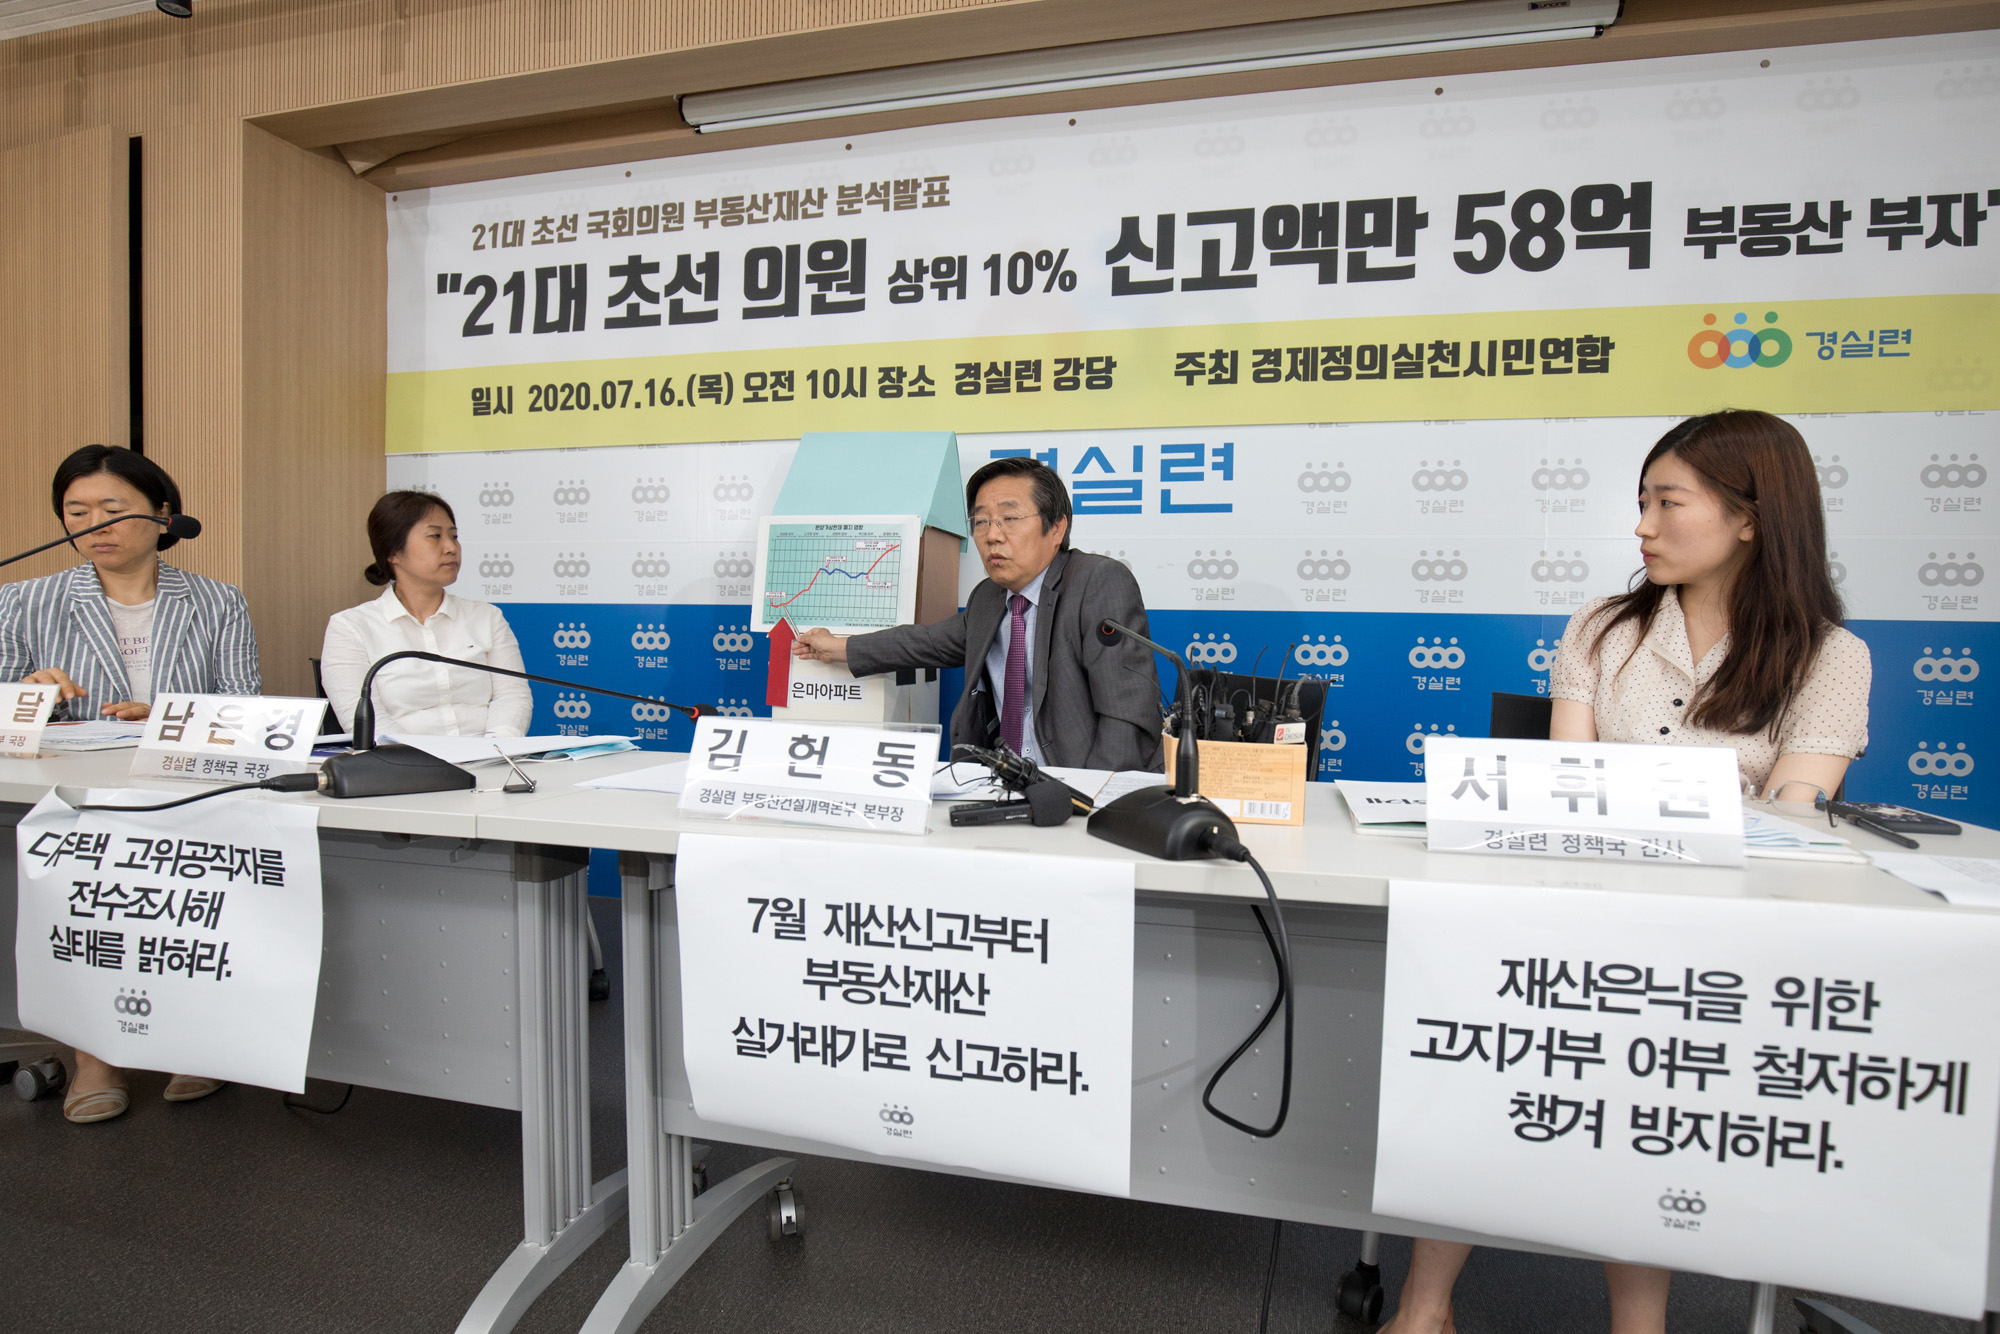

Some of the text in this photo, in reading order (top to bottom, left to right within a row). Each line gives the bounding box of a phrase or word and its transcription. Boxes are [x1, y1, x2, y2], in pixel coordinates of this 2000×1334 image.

[472, 176, 950, 251] 21대 초선 국회의원 부동산재산 분석발표
[437, 263, 587, 337] "21대
[604, 251, 719, 329] 초선
[743, 238, 866, 319] 의원
[888, 255, 967, 304] 상위
[984, 249, 1077, 296] 10%
[1106, 196, 1428, 296] 신고액만
[1454, 181, 1652, 274] 58억
[1684, 200, 1851, 259] 부동산
[472, 329, 1911, 416] 일시 2020.07.16.(목) 오전 10시 장소 경실련 강당 주최 경제정의실천시민연합 경실련
[557, 655, 588, 666] 경실련
[635, 656, 667, 668] 경실련
[716, 659, 750, 670] 경실련
[1412, 676, 1460, 690] 경실련
[12, 690, 45, 723] 달
[792, 683, 861, 700] 은마아파트
[1917, 690, 1973, 705] 경실련
[9, 735, 27, 748] 국장
[158, 700, 196, 743] 남
[163, 756, 269, 778] 경실련 정책국 국장
[707, 726, 917, 788] 김 헌 동
[698, 786, 737, 804] 경실련
[862, 801, 904, 823] 본부장
[1450, 754, 1508, 811] 서
[1550, 757, 1608, 816] 휘
[114, 838, 285, 887] 고위공직자를
[1484, 829, 1548, 853] 경실련
[1560, 833, 1628, 856] 정책국
[68, 881, 225, 929] 전수조사해
[50, 925, 231, 981] 실태를 밝혀라.
[748, 898, 1048, 964] 7월 재산신고부터
[803, 958, 990, 1016] 부동산재산
[1497, 958, 1880, 1033] 재산은닉을 위한
[732, 1017, 1088, 1095] 실거래가로 신고하라.
[1411, 1018, 1968, 1115] 고지거부 여부 철저하게
[1509, 1092, 1843, 1173] 챙겨 방지하라.
